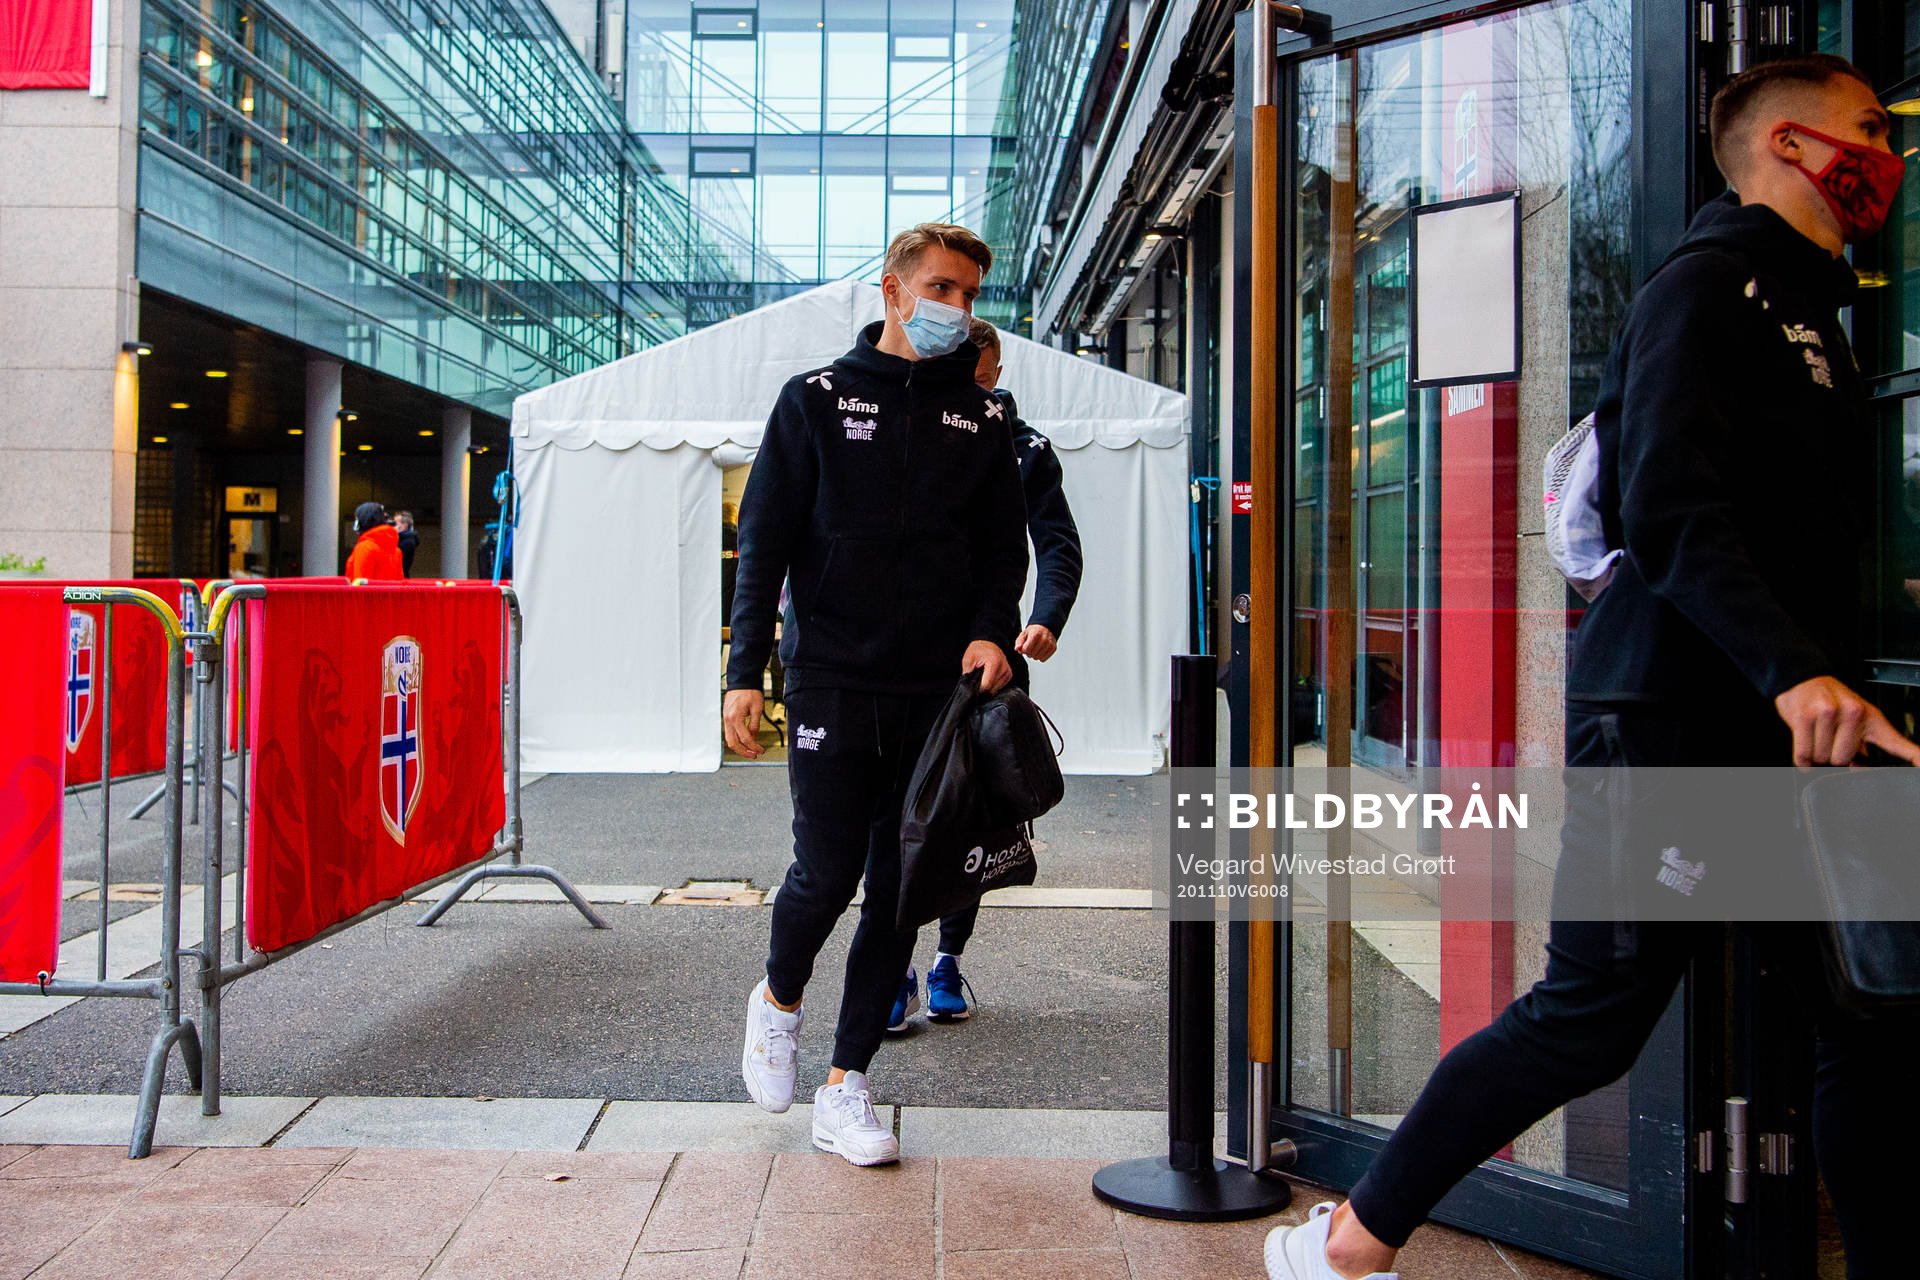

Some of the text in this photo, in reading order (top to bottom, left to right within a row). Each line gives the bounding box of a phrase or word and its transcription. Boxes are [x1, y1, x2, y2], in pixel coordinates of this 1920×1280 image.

[846, 429, 873, 441] NORGE
[243, 493, 261, 506] M
[797, 737, 820, 750] NORGE
